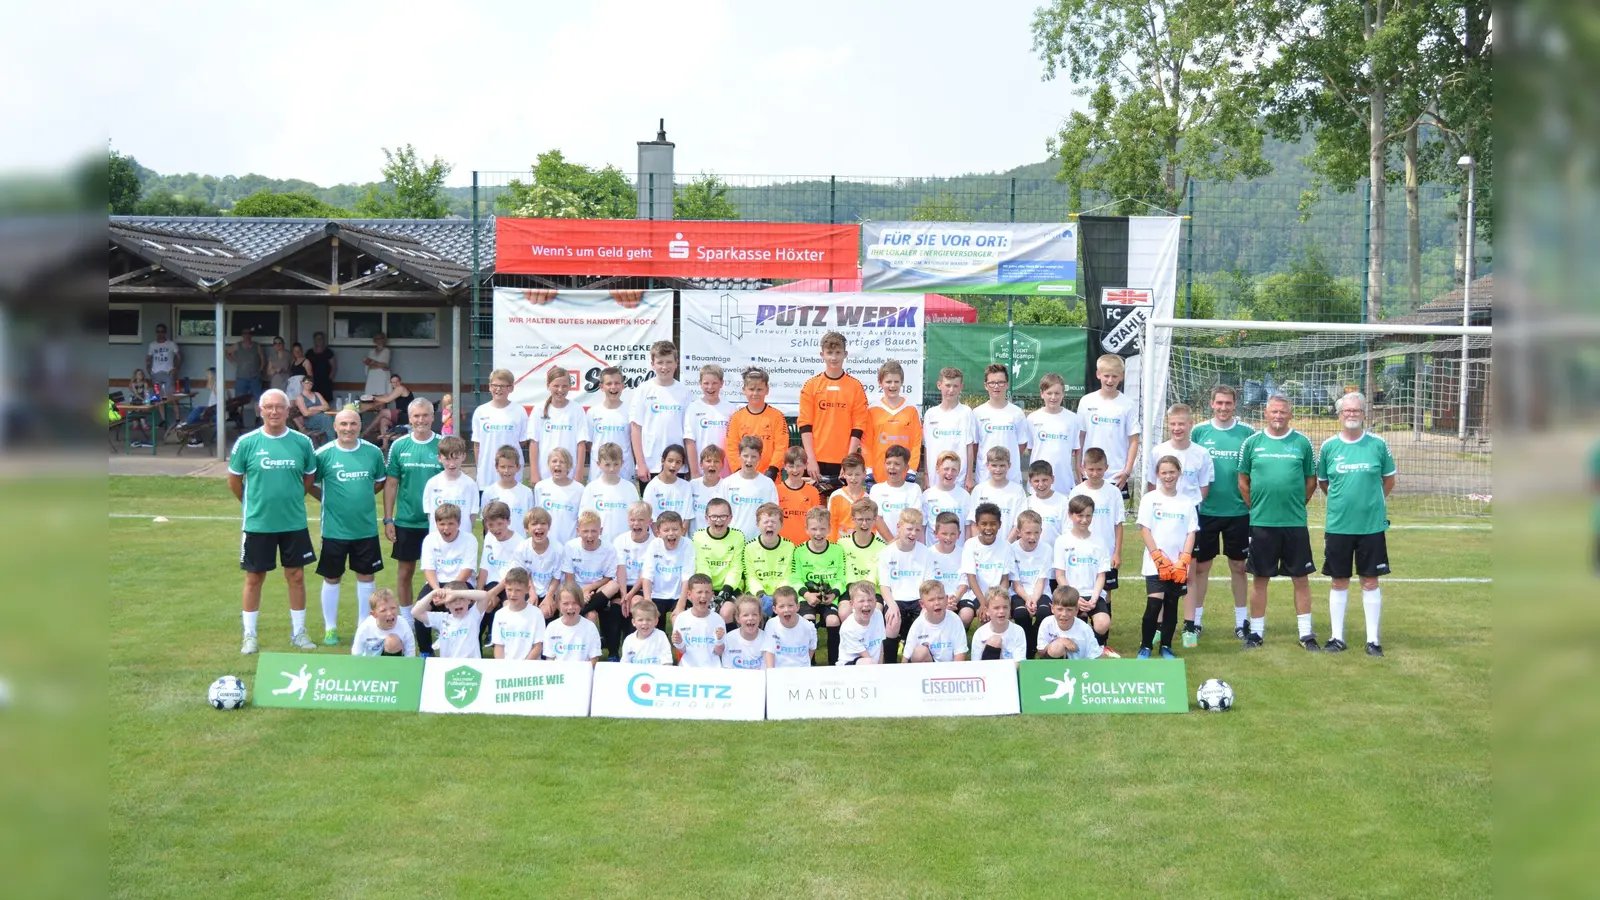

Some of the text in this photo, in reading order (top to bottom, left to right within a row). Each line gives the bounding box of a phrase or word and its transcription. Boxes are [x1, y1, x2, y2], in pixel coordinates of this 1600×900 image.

[883, 231, 1008, 248] FÜR SIE VOR ORT:
[532, 245, 653, 260] Wenn's um Geld geht
[697, 246, 771, 262] Sparkasse
[776, 248, 825, 262] Höxter
[756, 304, 919, 328] PUTZ WERK
[1106, 308, 1122, 320] FC
[884, 336, 918, 346] Bauen
[692, 355, 731, 363] Bauanträge
[315, 678, 400, 693] HOLLYVENT
[496, 674, 565, 689] TRAINIERE WIE
[1081, 682, 1165, 694] HOLLYVENT
[496, 690, 544, 704] EIN PROFI!
[656, 683, 732, 699] REITZ
[788, 686, 878, 701] MANCUSI
[654, 700, 732, 709] GROUP
